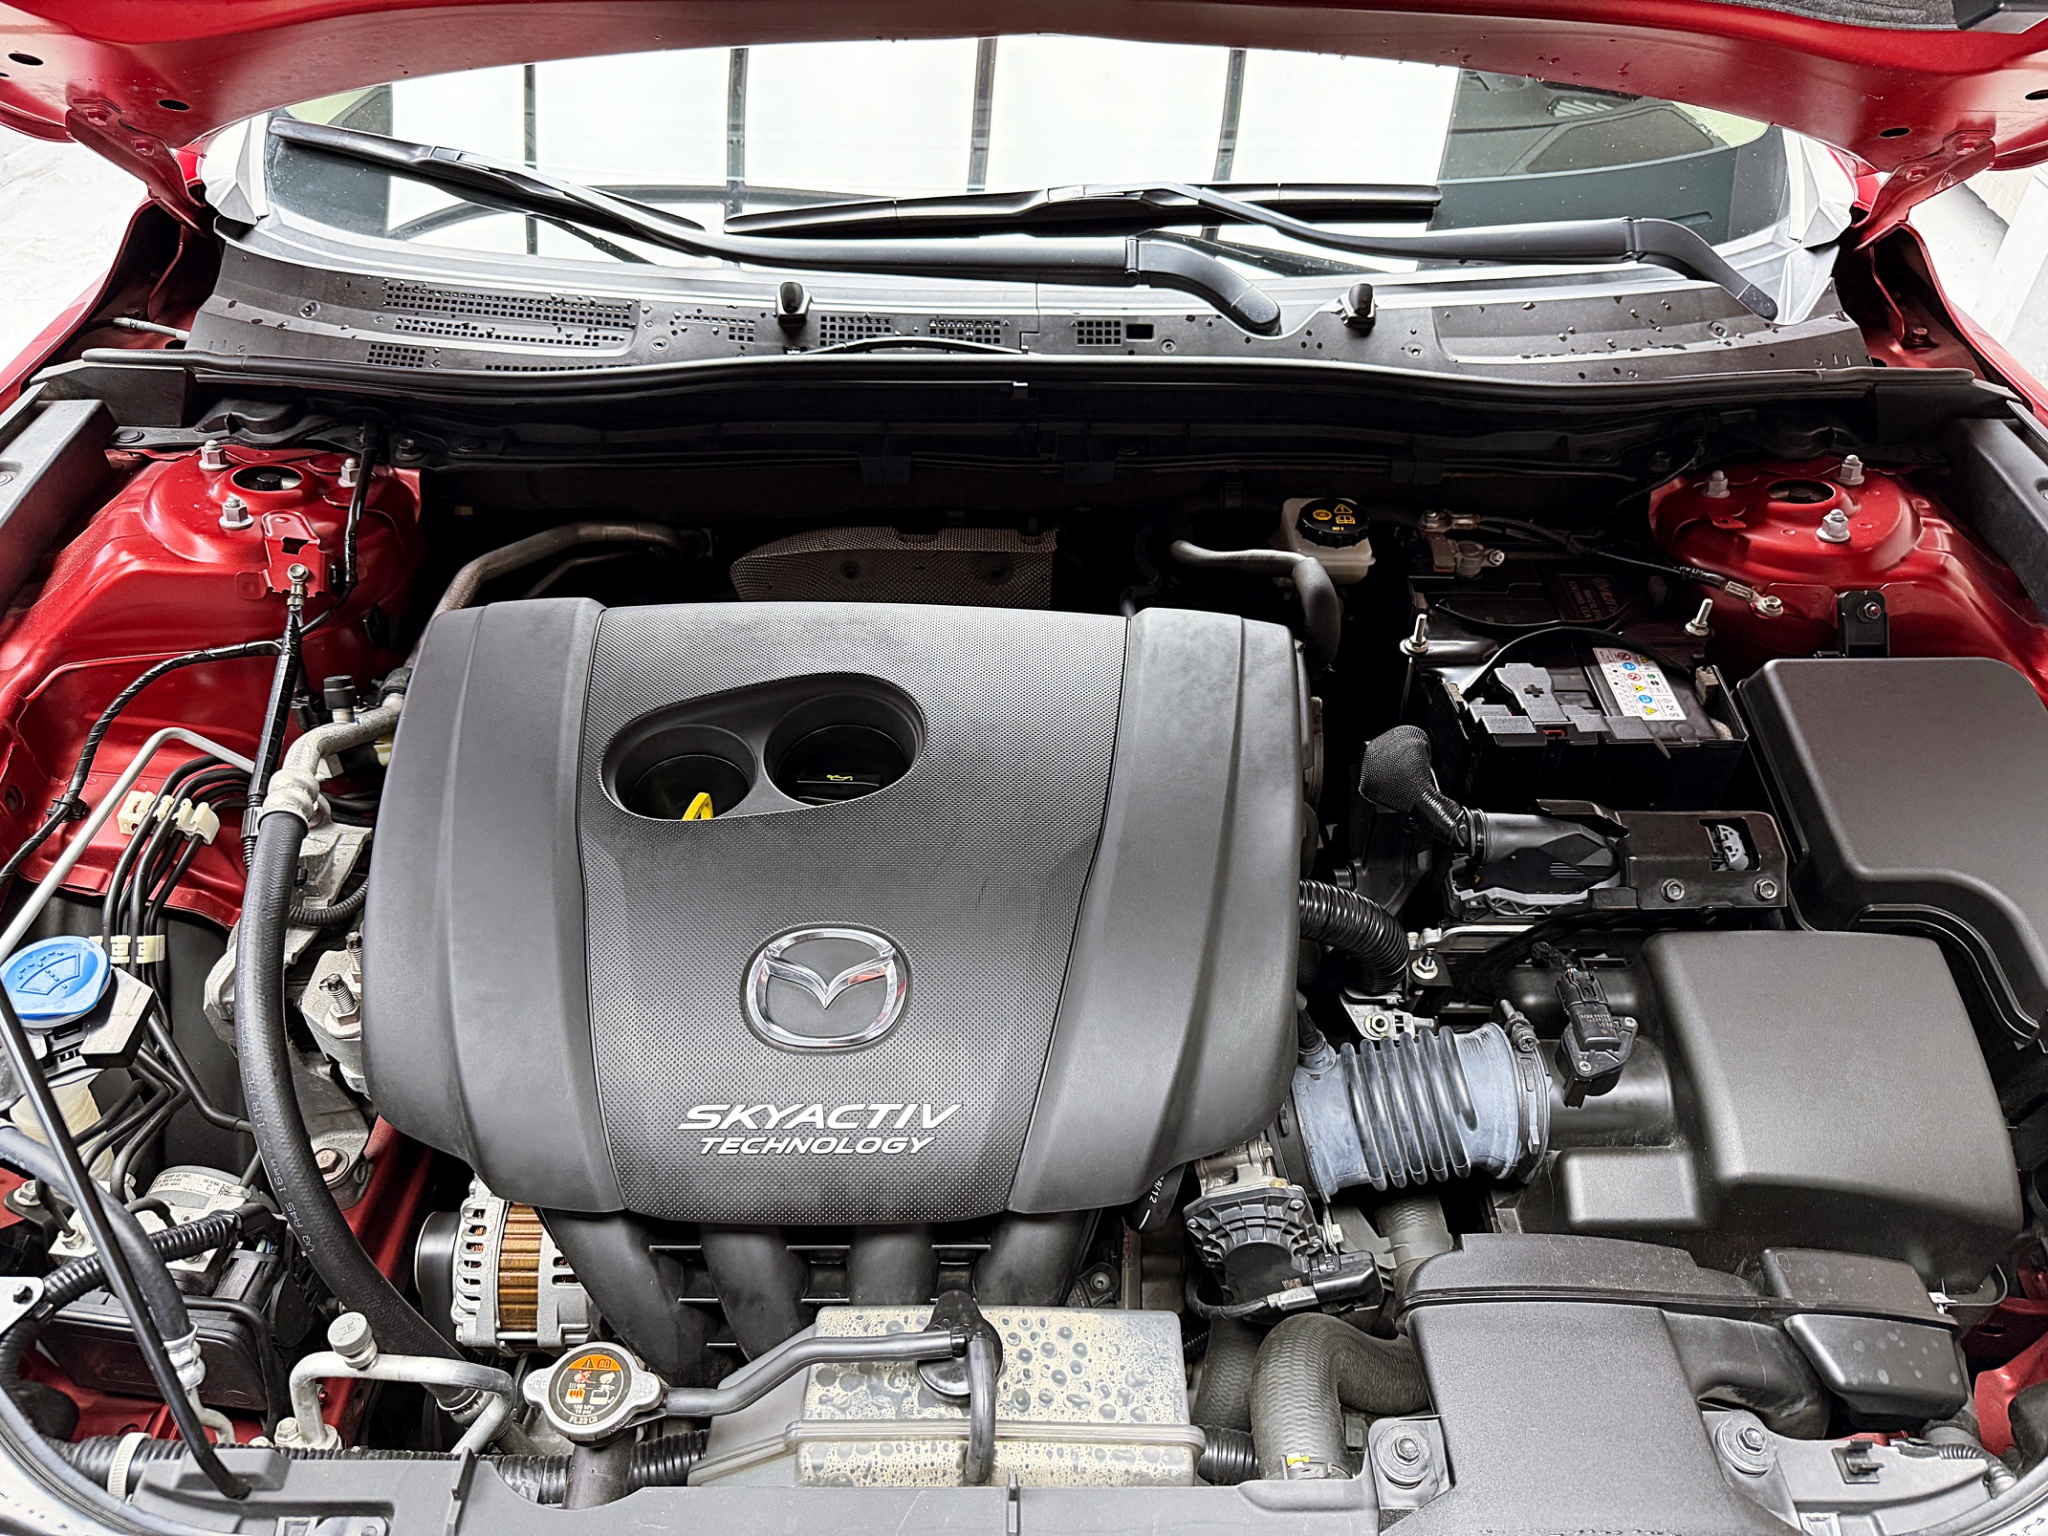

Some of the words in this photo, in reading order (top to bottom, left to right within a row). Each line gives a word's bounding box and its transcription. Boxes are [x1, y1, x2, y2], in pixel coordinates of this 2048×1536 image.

[240, 1018, 251, 1057] EPDM
[245, 1066, 257, 1094] PET
[677, 1103, 964, 1131] SKYACTIV
[699, 1136, 937, 1156] TECHNOLOGY
[270, 1158, 287, 1193] 16mm
[569, 1416, 588, 1425] FL22
